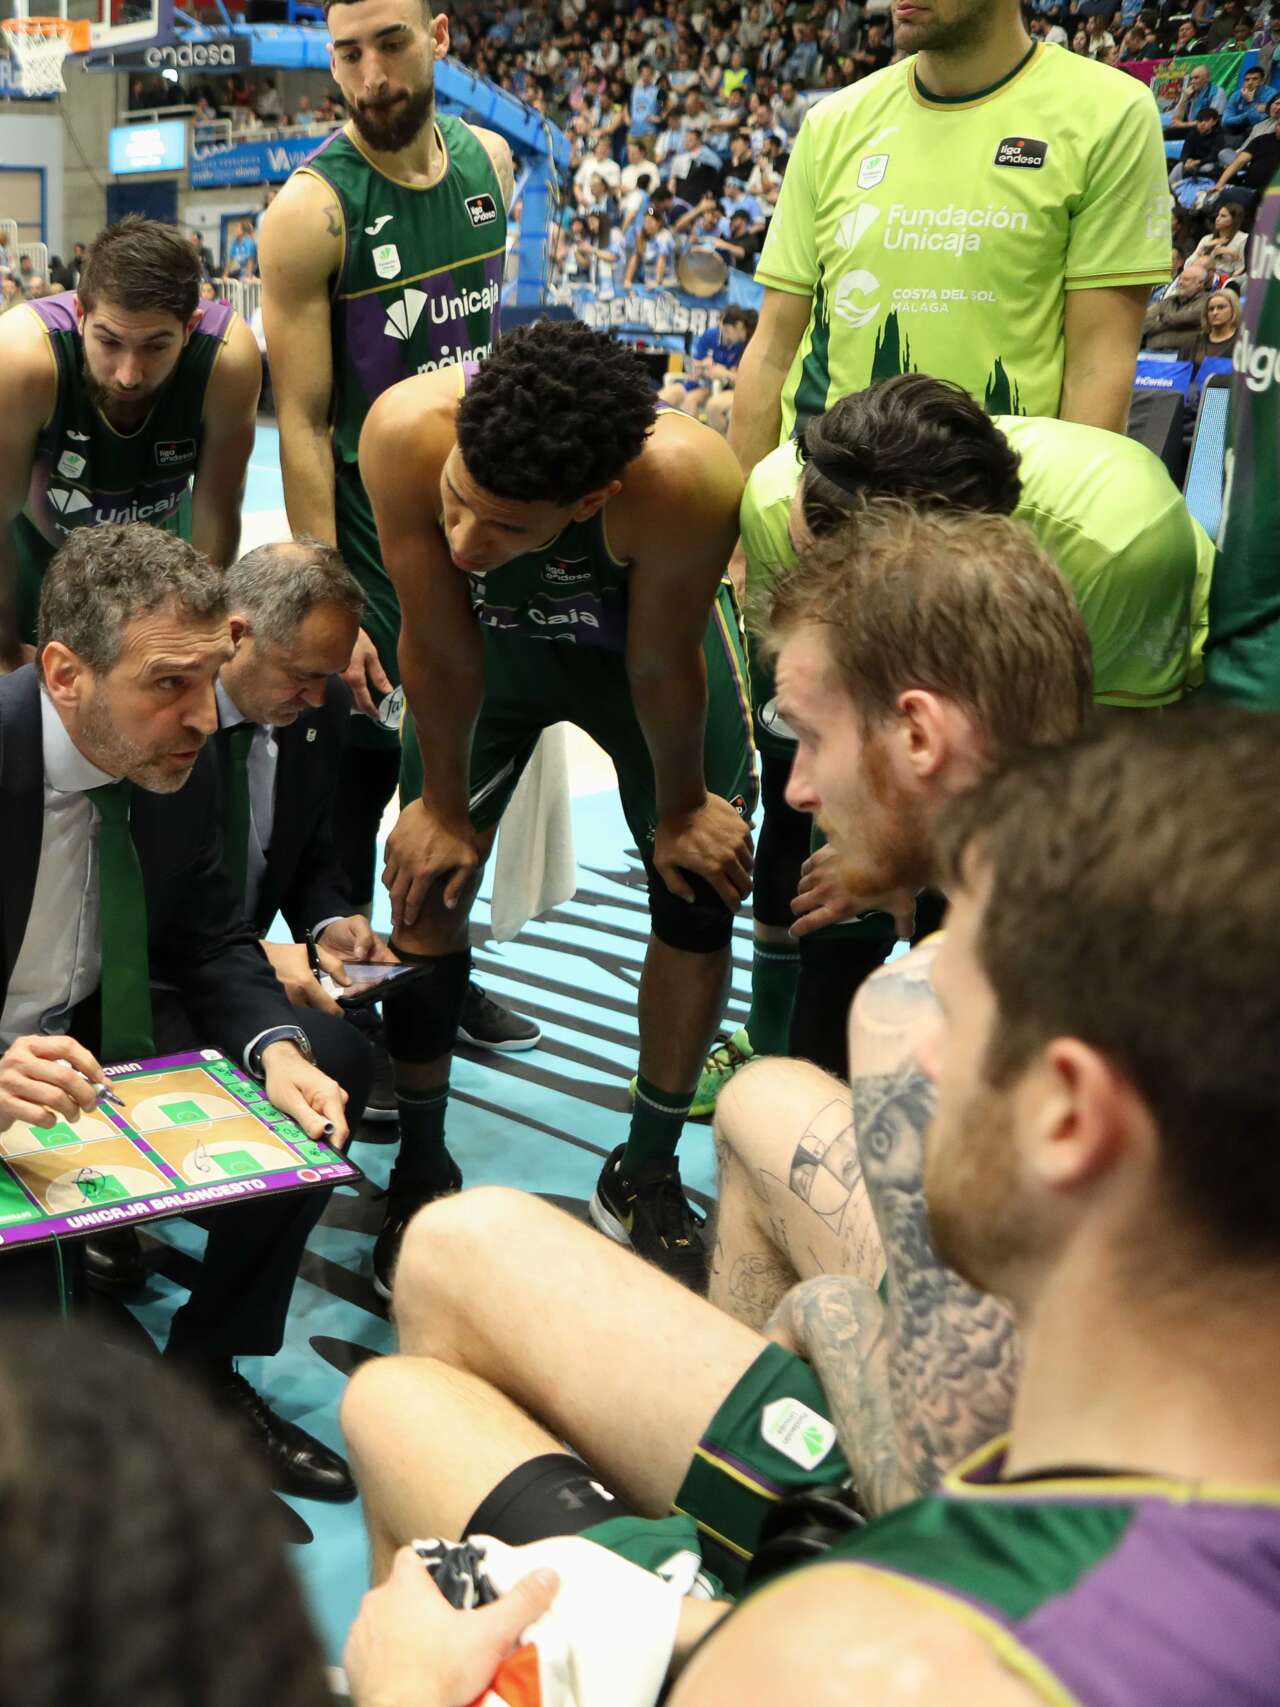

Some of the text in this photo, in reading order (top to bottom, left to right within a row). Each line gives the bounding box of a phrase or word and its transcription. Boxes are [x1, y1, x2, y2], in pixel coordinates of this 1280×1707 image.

[144, 40, 236, 68] endesa
[998, 153, 1042, 166] endesa
[1000, 144, 1021, 155] liga
[886, 203, 1029, 231] Fundación
[882, 227, 982, 257] Unicaja
[430, 279, 500, 324] Unicaja
[892, 288, 996, 301] COSTA DEL SOL
[102, 1062, 143, 1076] UNIC
[66, 1202, 150, 1229] UNICAJA
[150, 1178, 267, 1210] BALONCESTO
